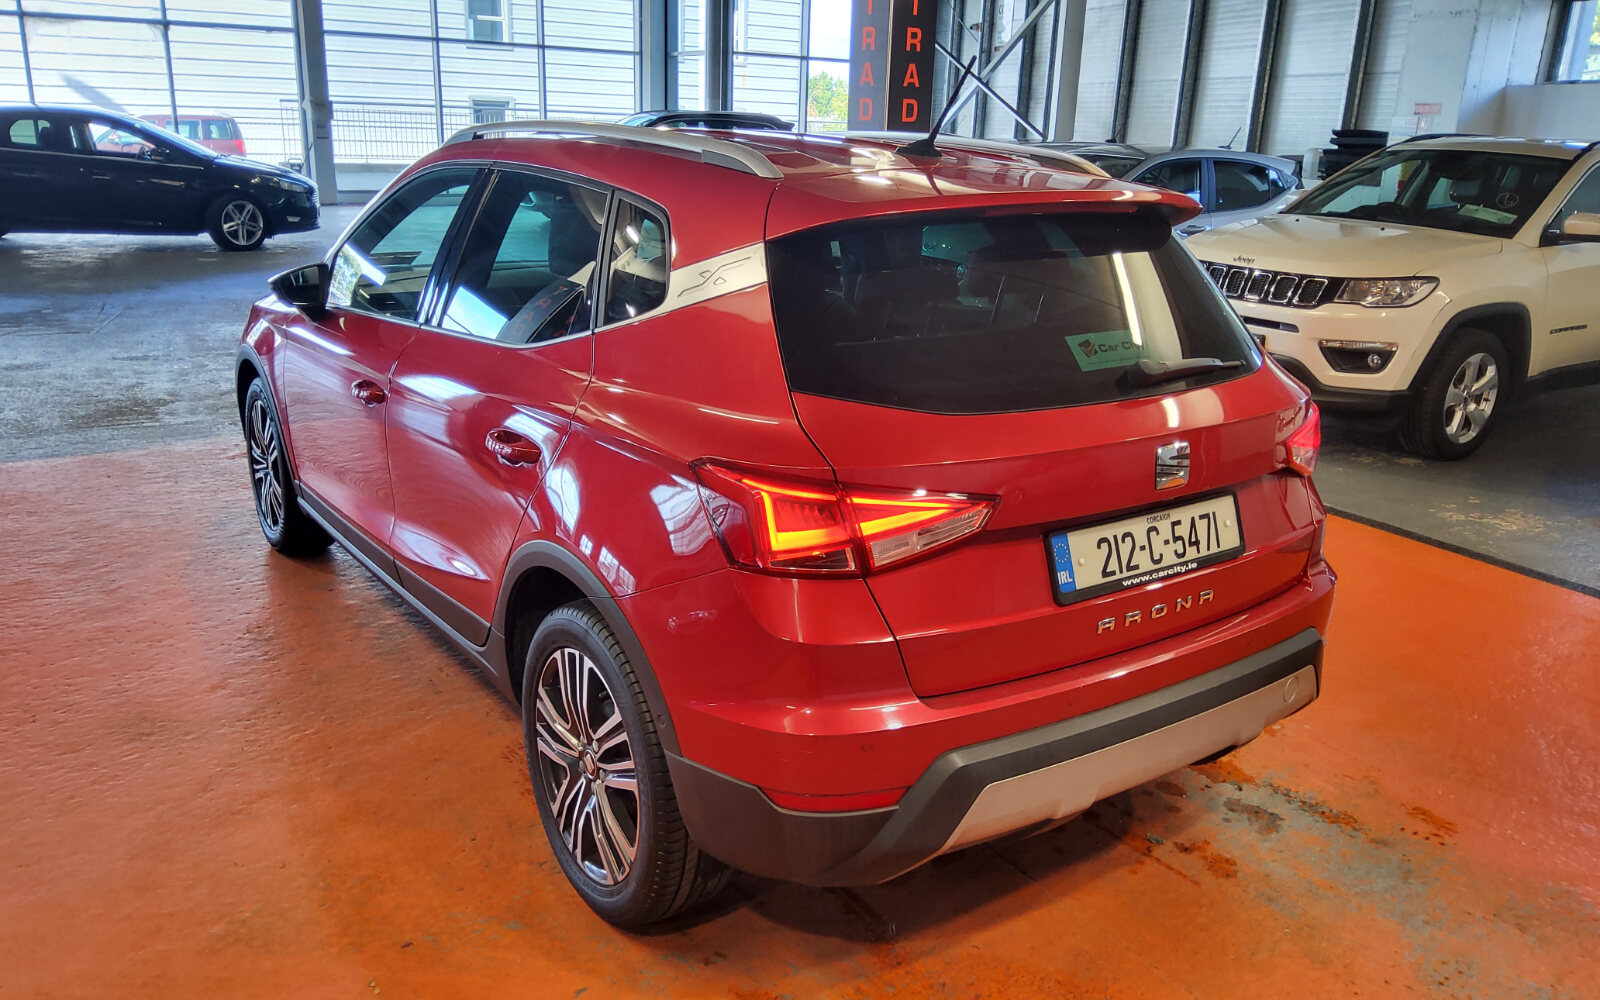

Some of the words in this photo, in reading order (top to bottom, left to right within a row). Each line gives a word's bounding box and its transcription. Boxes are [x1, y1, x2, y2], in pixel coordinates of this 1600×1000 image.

[1098, 343, 1119, 353] Car
[1096, 511, 1221, 579] 212-C-5471
[1057, 571, 1073, 585] IRL
[1121, 561, 1198, 587] www.carcity.ie
[1096, 589, 1214, 635] ARONA
